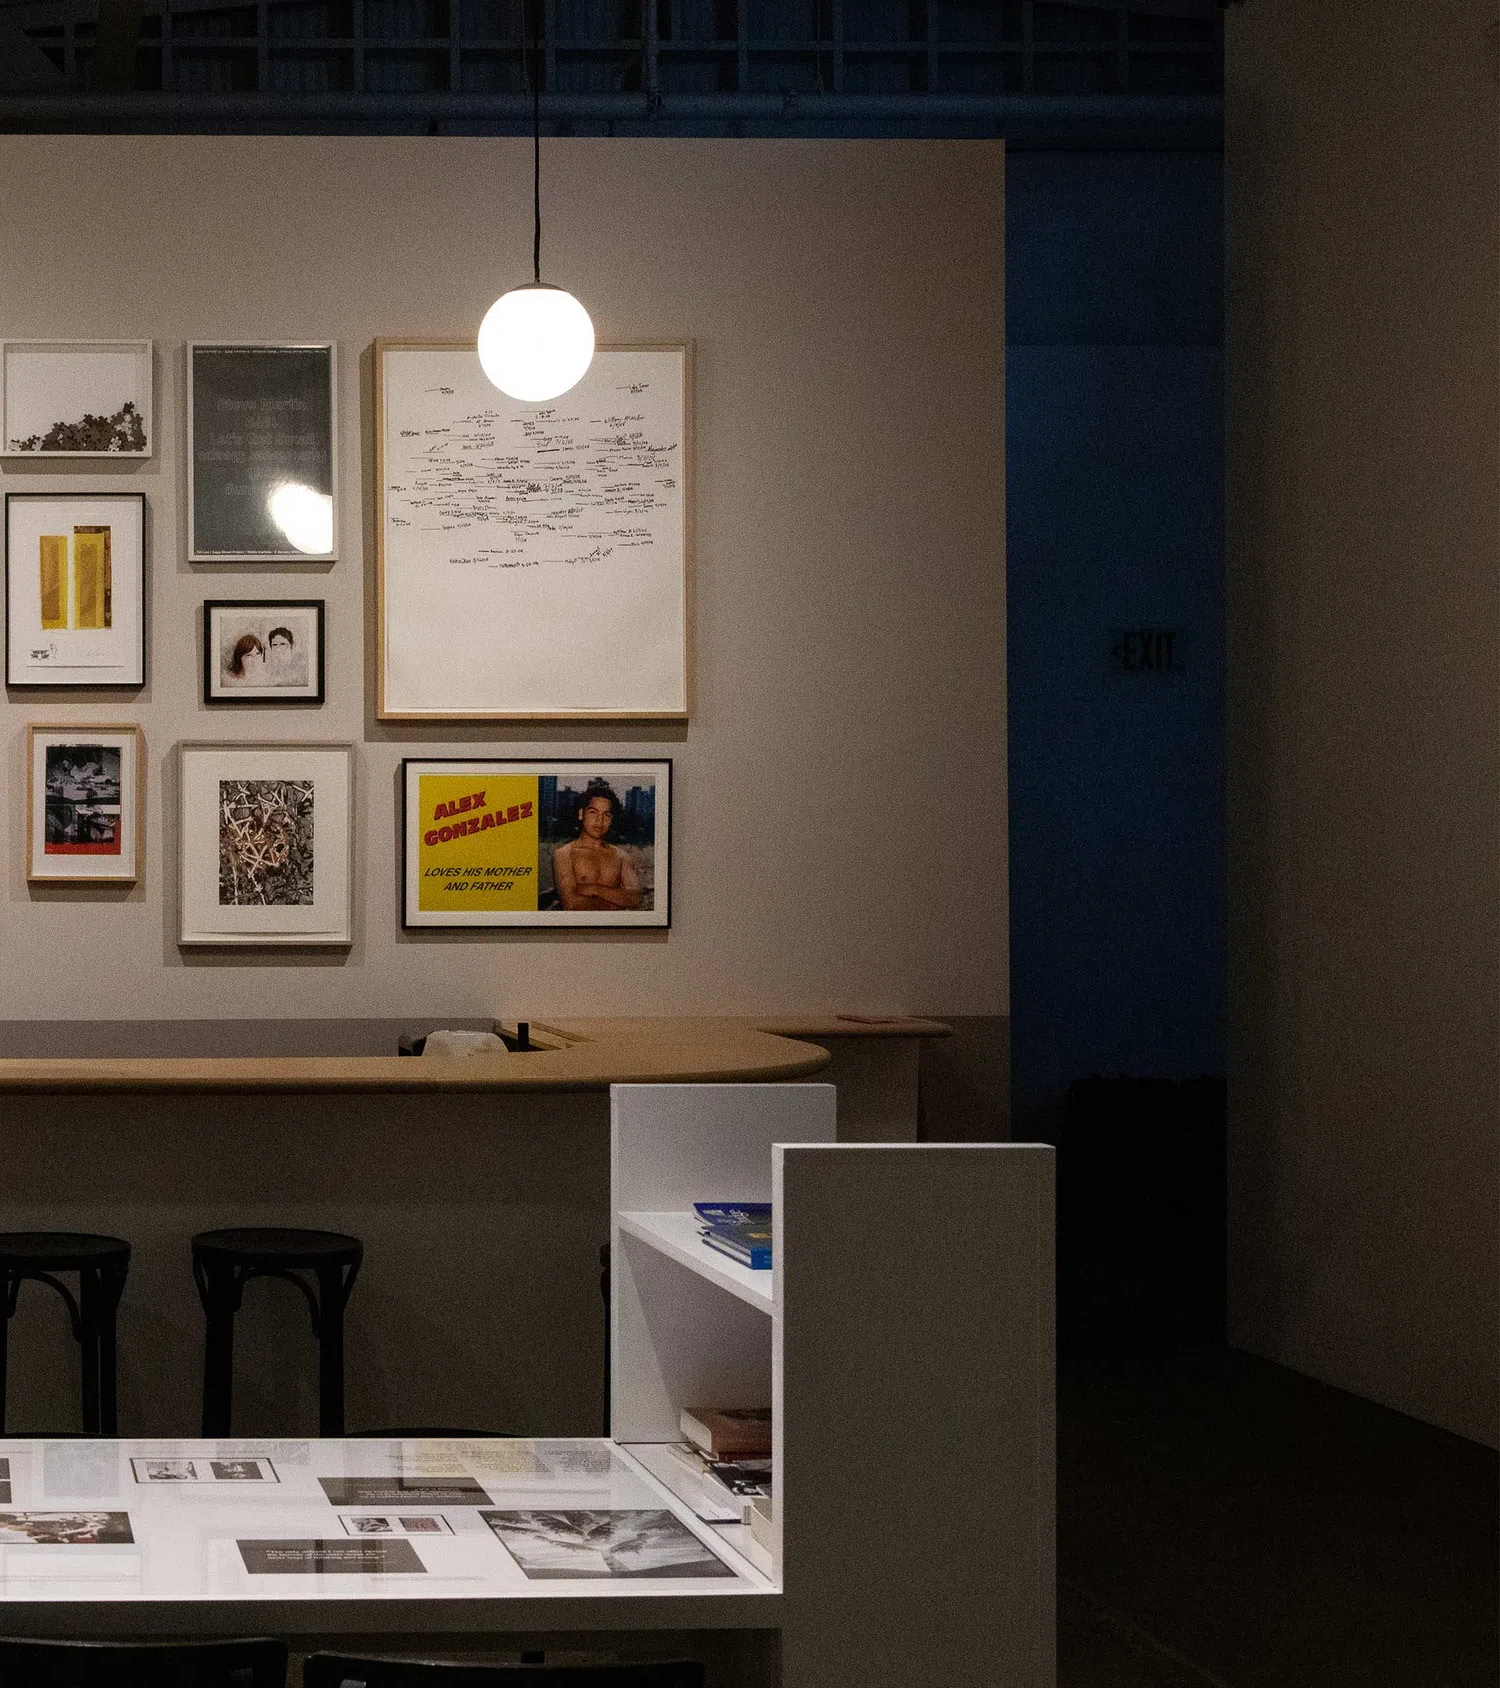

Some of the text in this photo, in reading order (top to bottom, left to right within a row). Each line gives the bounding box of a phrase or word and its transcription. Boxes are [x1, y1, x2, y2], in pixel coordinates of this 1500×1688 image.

[1123, 631, 1177, 670] EXIT
[433, 790, 487, 821] ALEX
[423, 801, 533, 847] GONZALEZ
[424, 867, 532, 877] LOVES HIS MOTHER
[443, 881, 514, 891] AND FATHER
